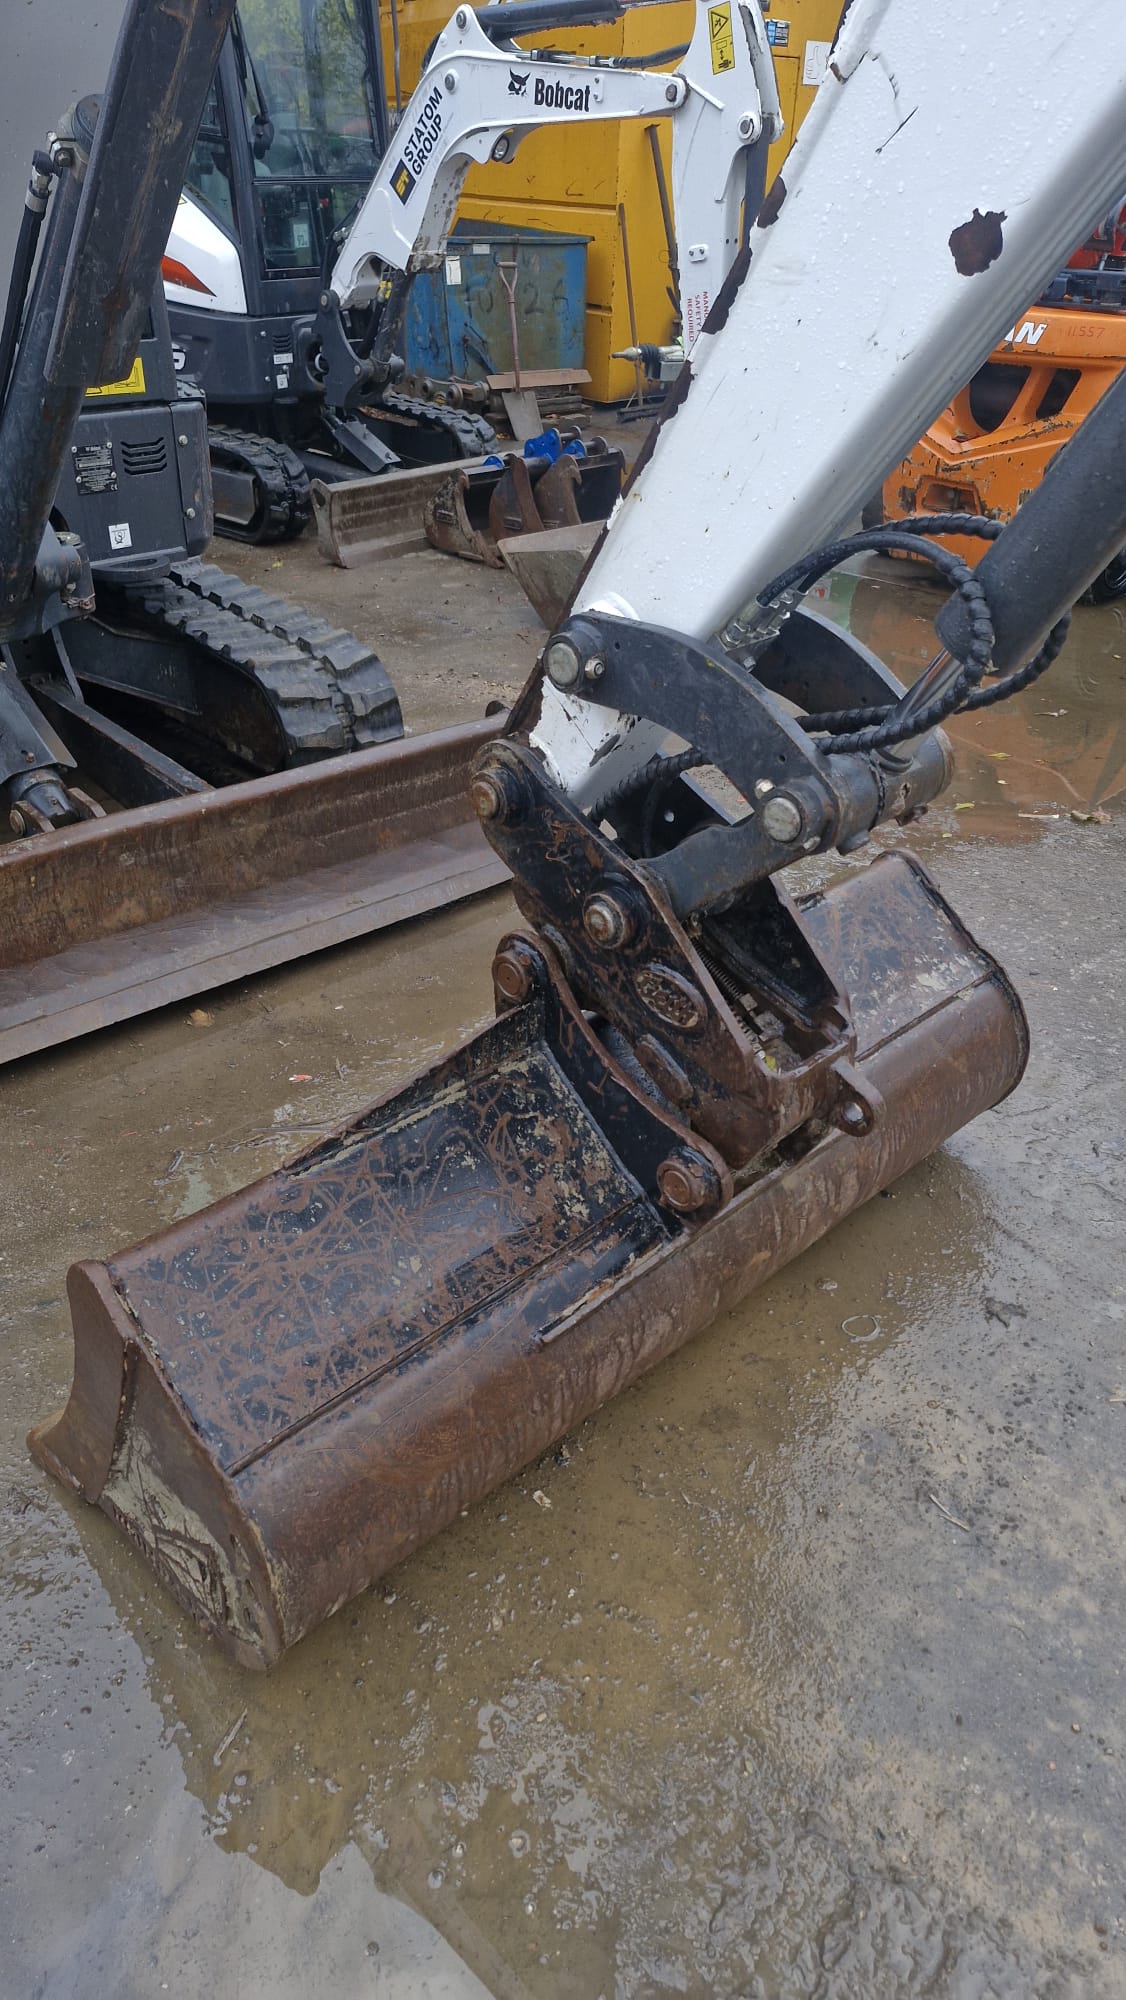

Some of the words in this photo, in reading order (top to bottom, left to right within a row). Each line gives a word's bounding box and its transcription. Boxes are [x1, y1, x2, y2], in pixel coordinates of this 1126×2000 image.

[404, 87, 443, 163] STATOM
[534, 78, 591, 112] Bobcat
[412, 113, 442, 177] GROUP
